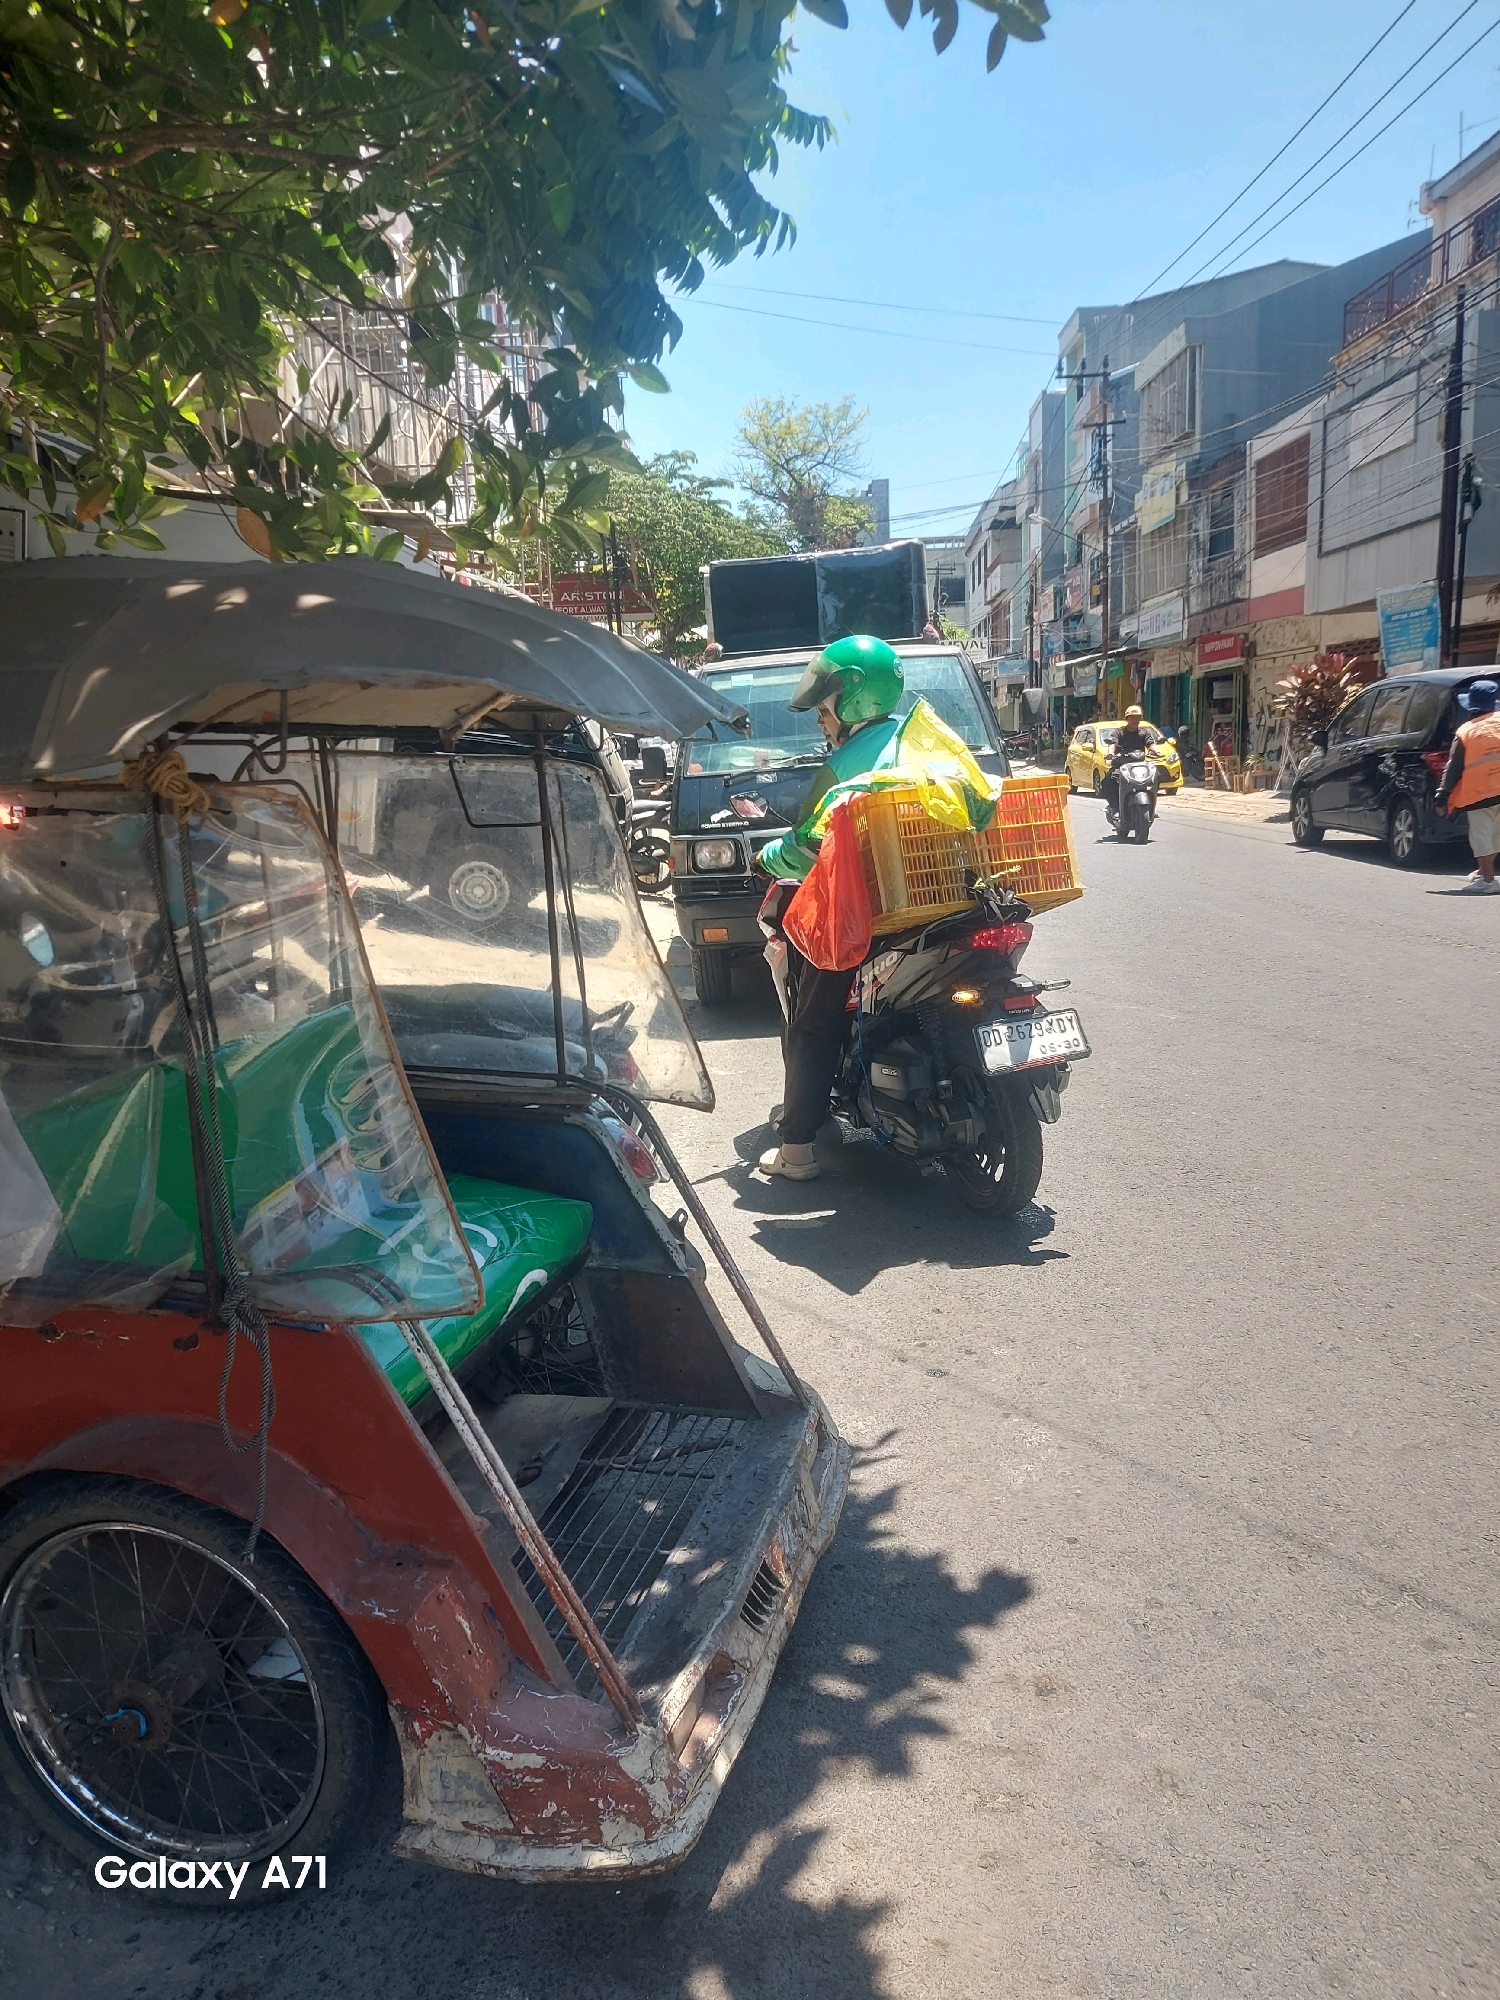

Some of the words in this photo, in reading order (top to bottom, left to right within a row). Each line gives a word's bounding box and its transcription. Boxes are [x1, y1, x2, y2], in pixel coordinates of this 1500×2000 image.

[982, 1028, 1003, 1048] DD
[1006, 1020, 1044, 1043] 2629
[1045, 1015, 1076, 1034] XDY
